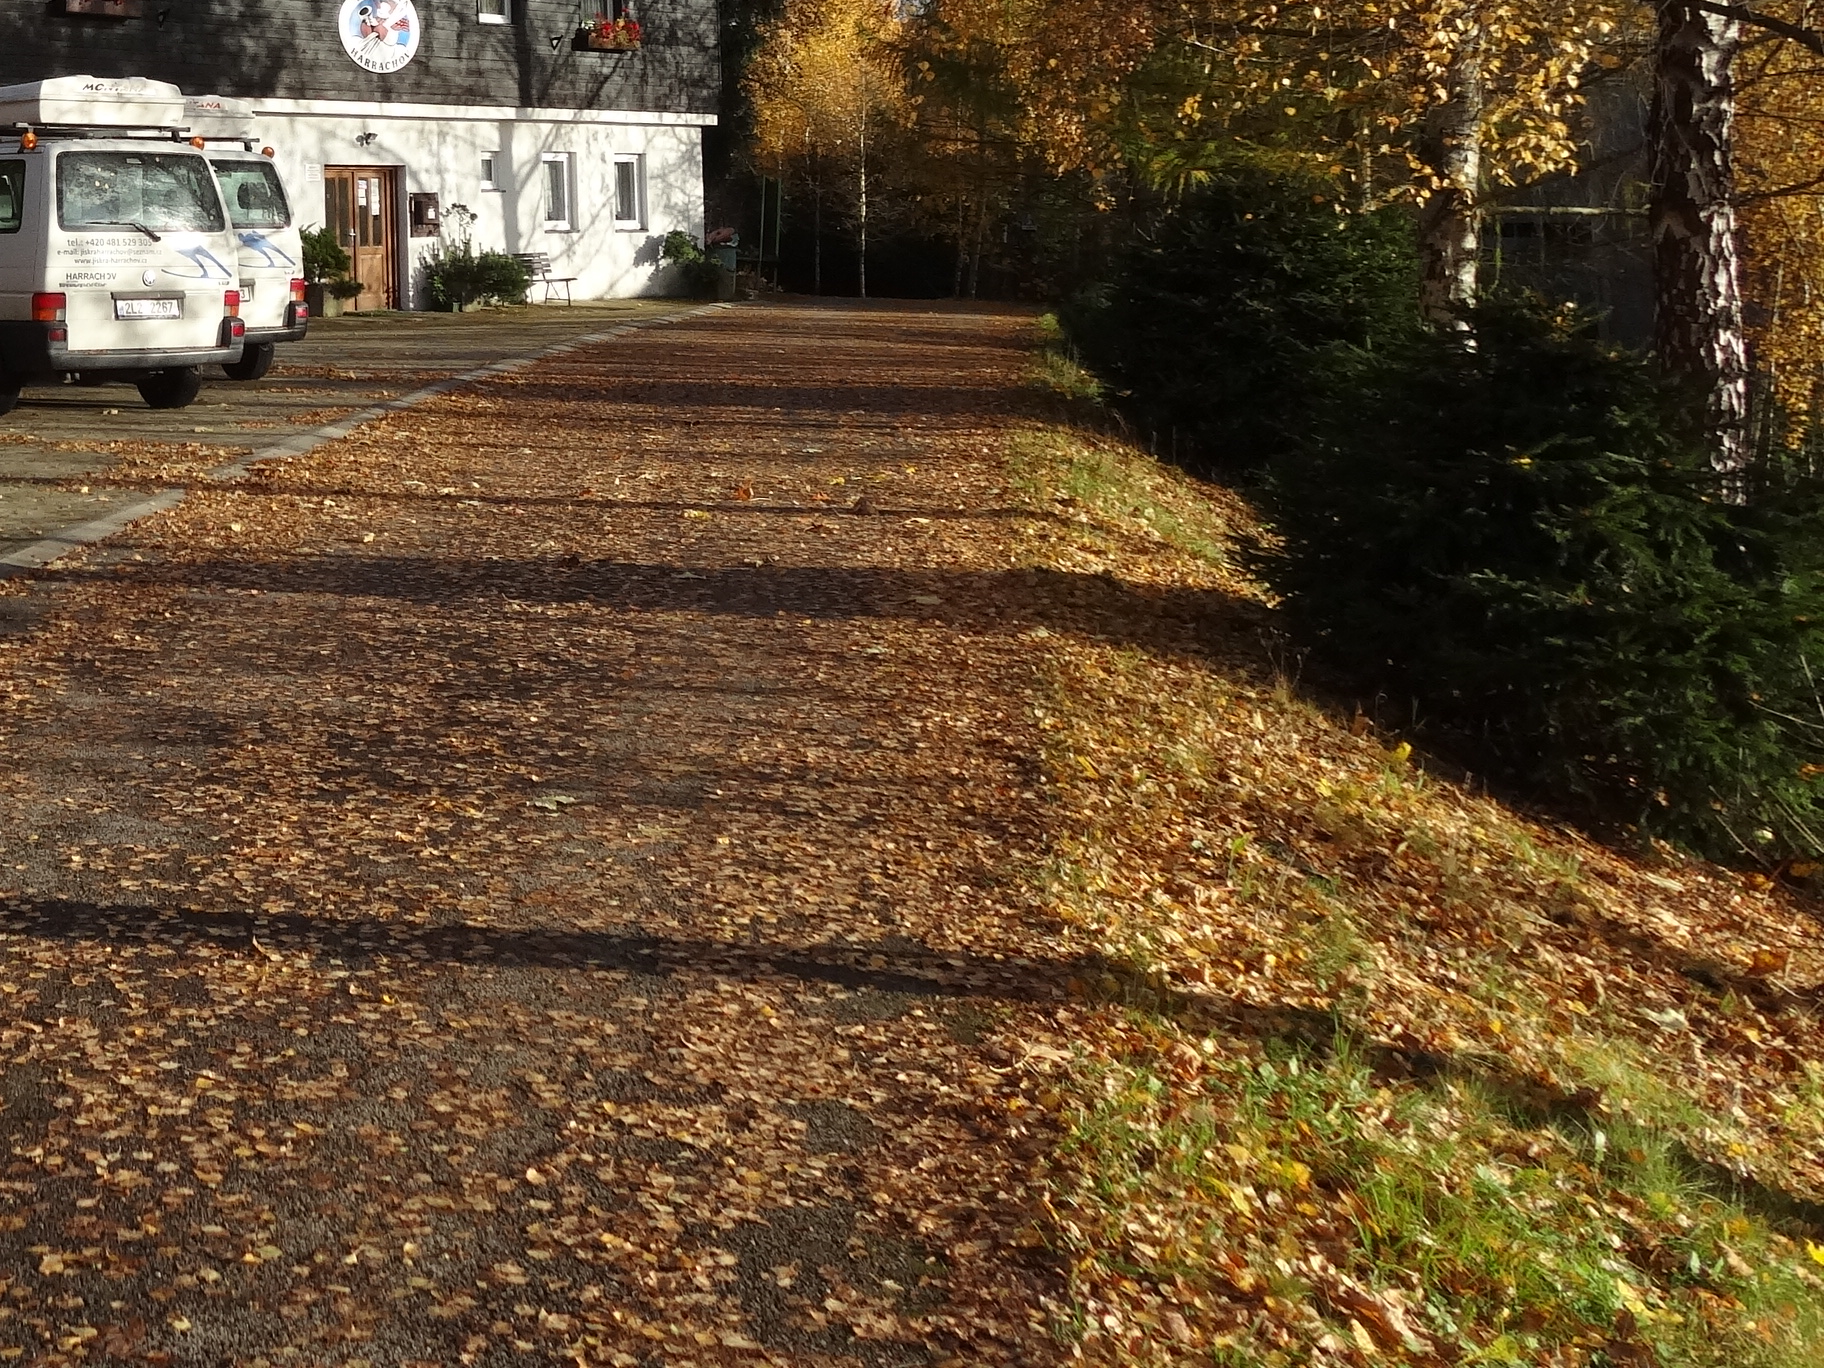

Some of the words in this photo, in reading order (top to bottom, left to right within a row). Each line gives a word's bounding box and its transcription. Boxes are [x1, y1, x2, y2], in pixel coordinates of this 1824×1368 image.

[350, 47, 411, 72] HARRACHOV
[85, 239, 104, 247] +420
[106, 239, 120, 247] 481
[122, 239, 136, 247] 529
[138, 239, 153, 247] 305
[150, 302, 173, 314] 2267
